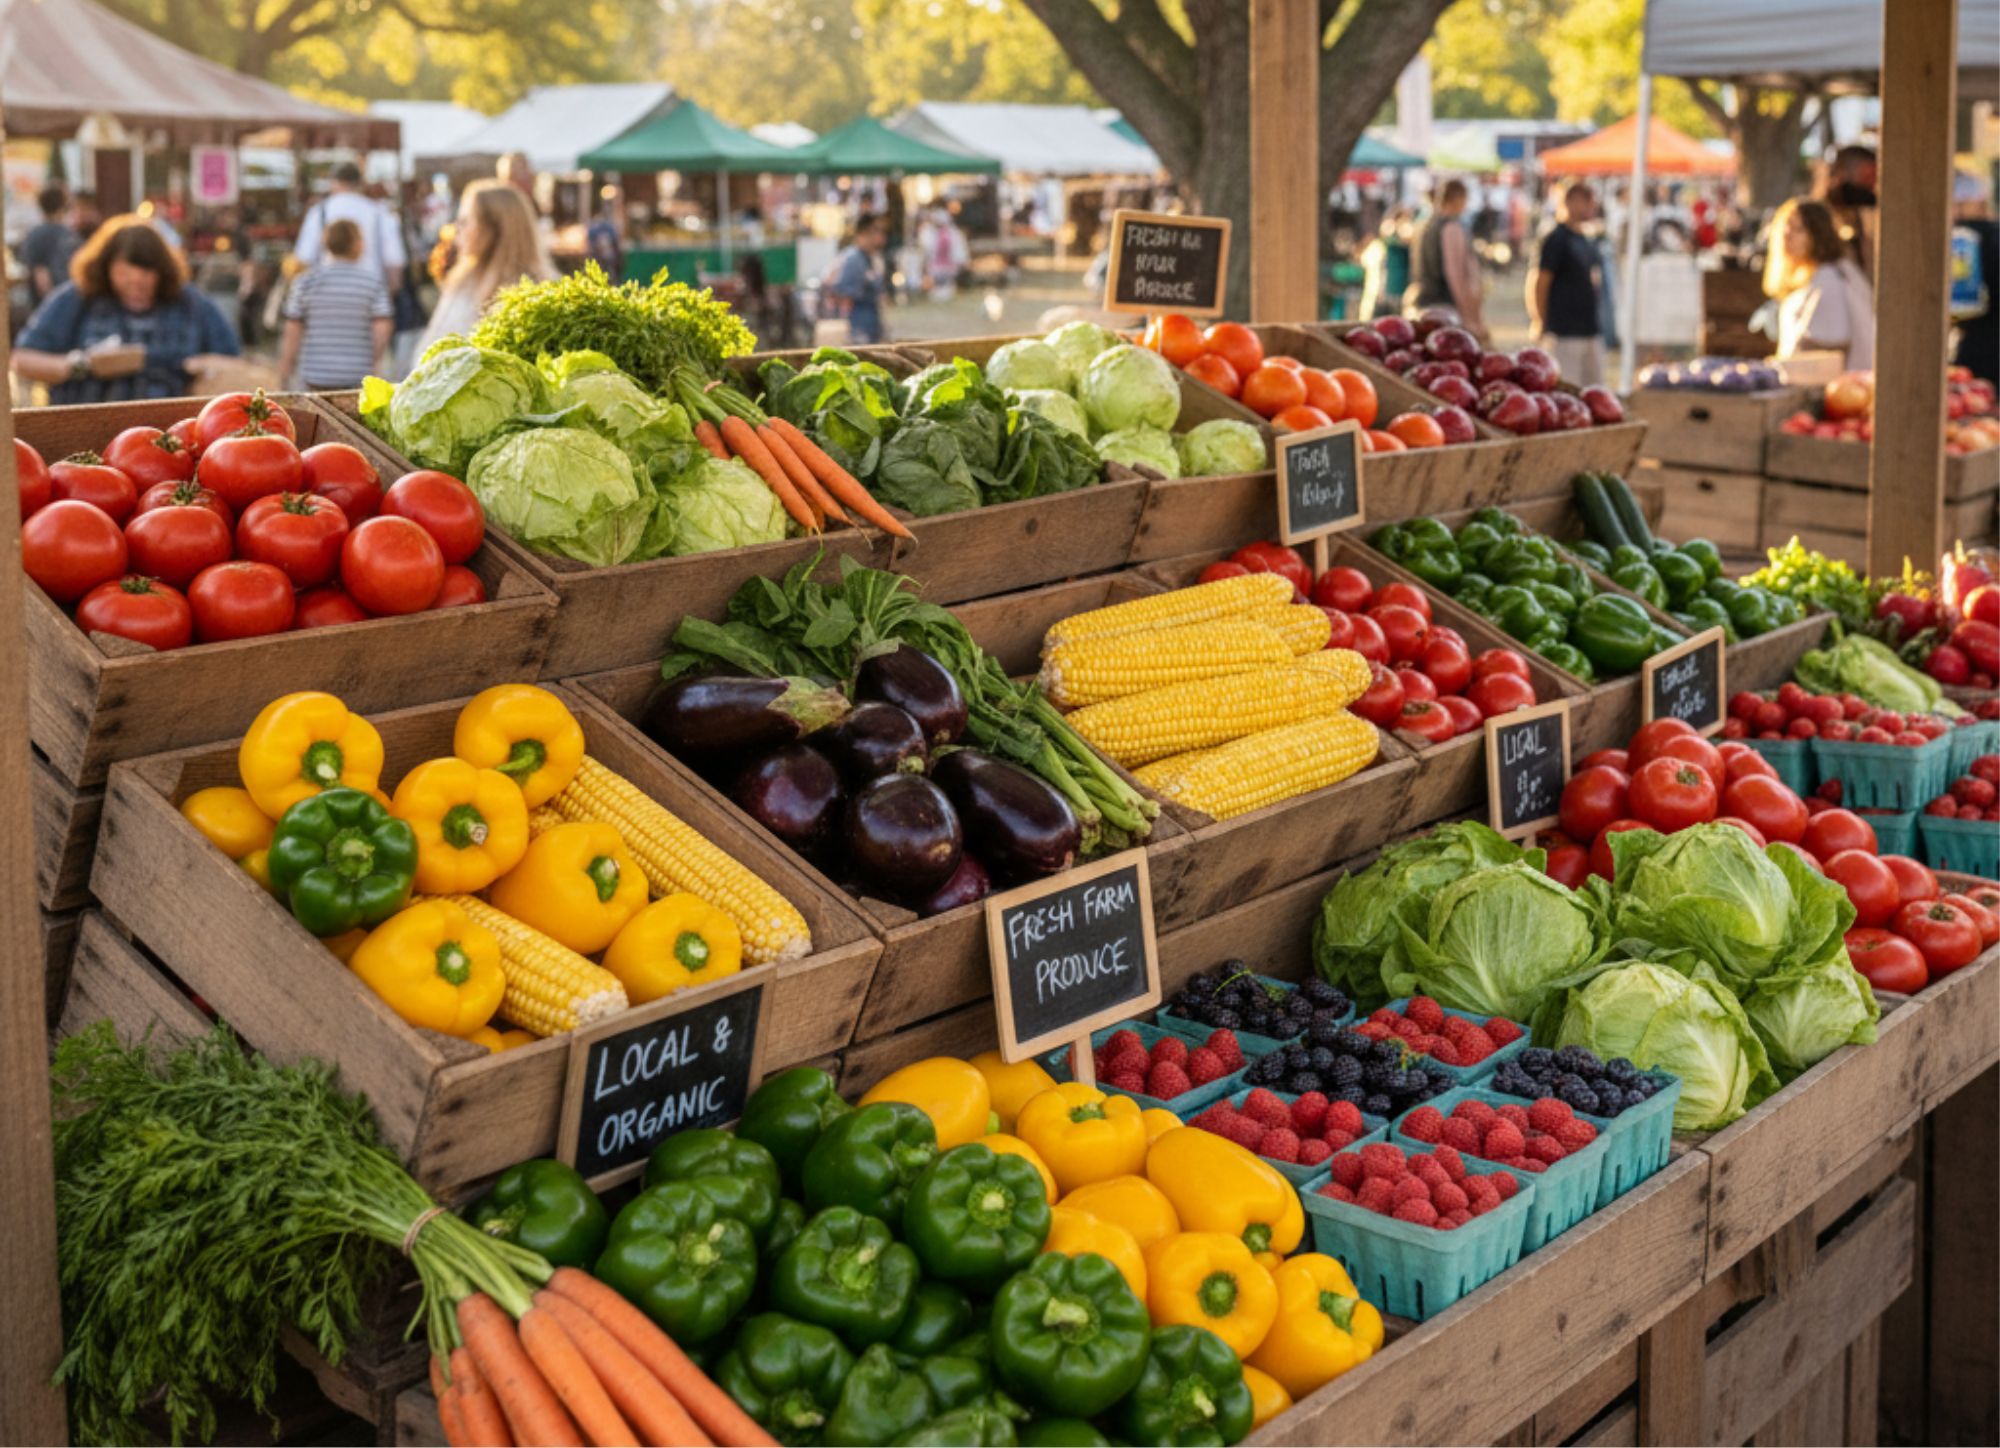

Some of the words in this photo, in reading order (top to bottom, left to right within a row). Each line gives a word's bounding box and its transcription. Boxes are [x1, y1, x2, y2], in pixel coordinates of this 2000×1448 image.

[1008, 900, 1075, 960] FRESH
[1083, 882, 1135, 925] FARM
[1035, 937, 1130, 1005] PRODUCE
[593, 1025, 699, 1102] LOCAL
[712, 1016, 733, 1053] &
[597, 1076, 726, 1157] ORGANIC
